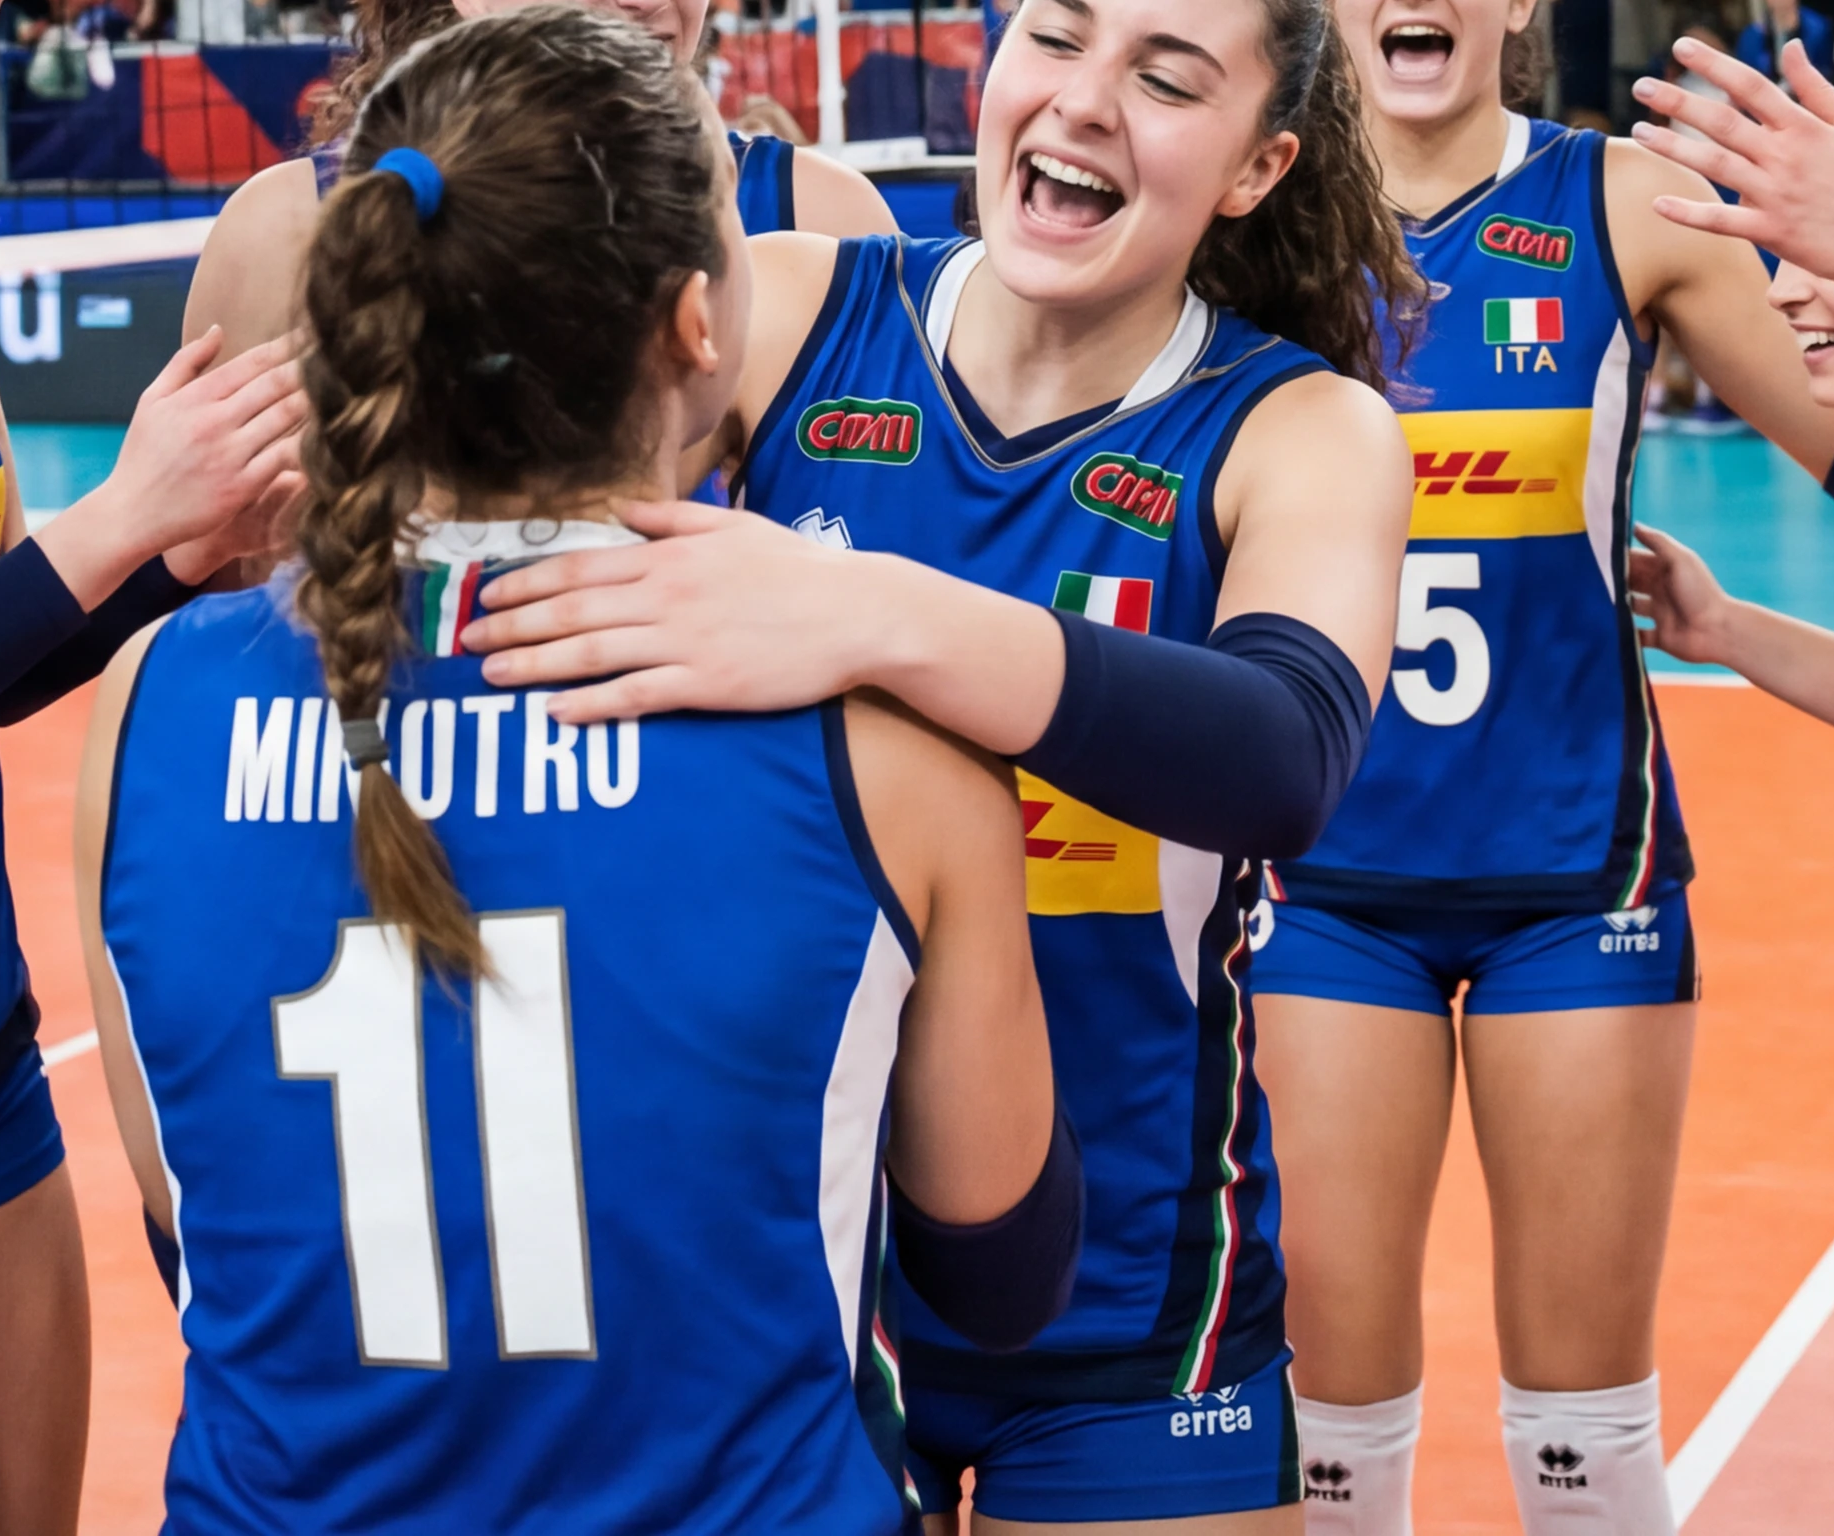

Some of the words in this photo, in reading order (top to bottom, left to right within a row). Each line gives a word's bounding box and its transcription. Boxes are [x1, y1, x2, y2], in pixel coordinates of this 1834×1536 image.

[1494, 345, 1558, 374] ITA
[270, 906, 599, 1371] 11
[1170, 1399, 1253, 1438] errea
